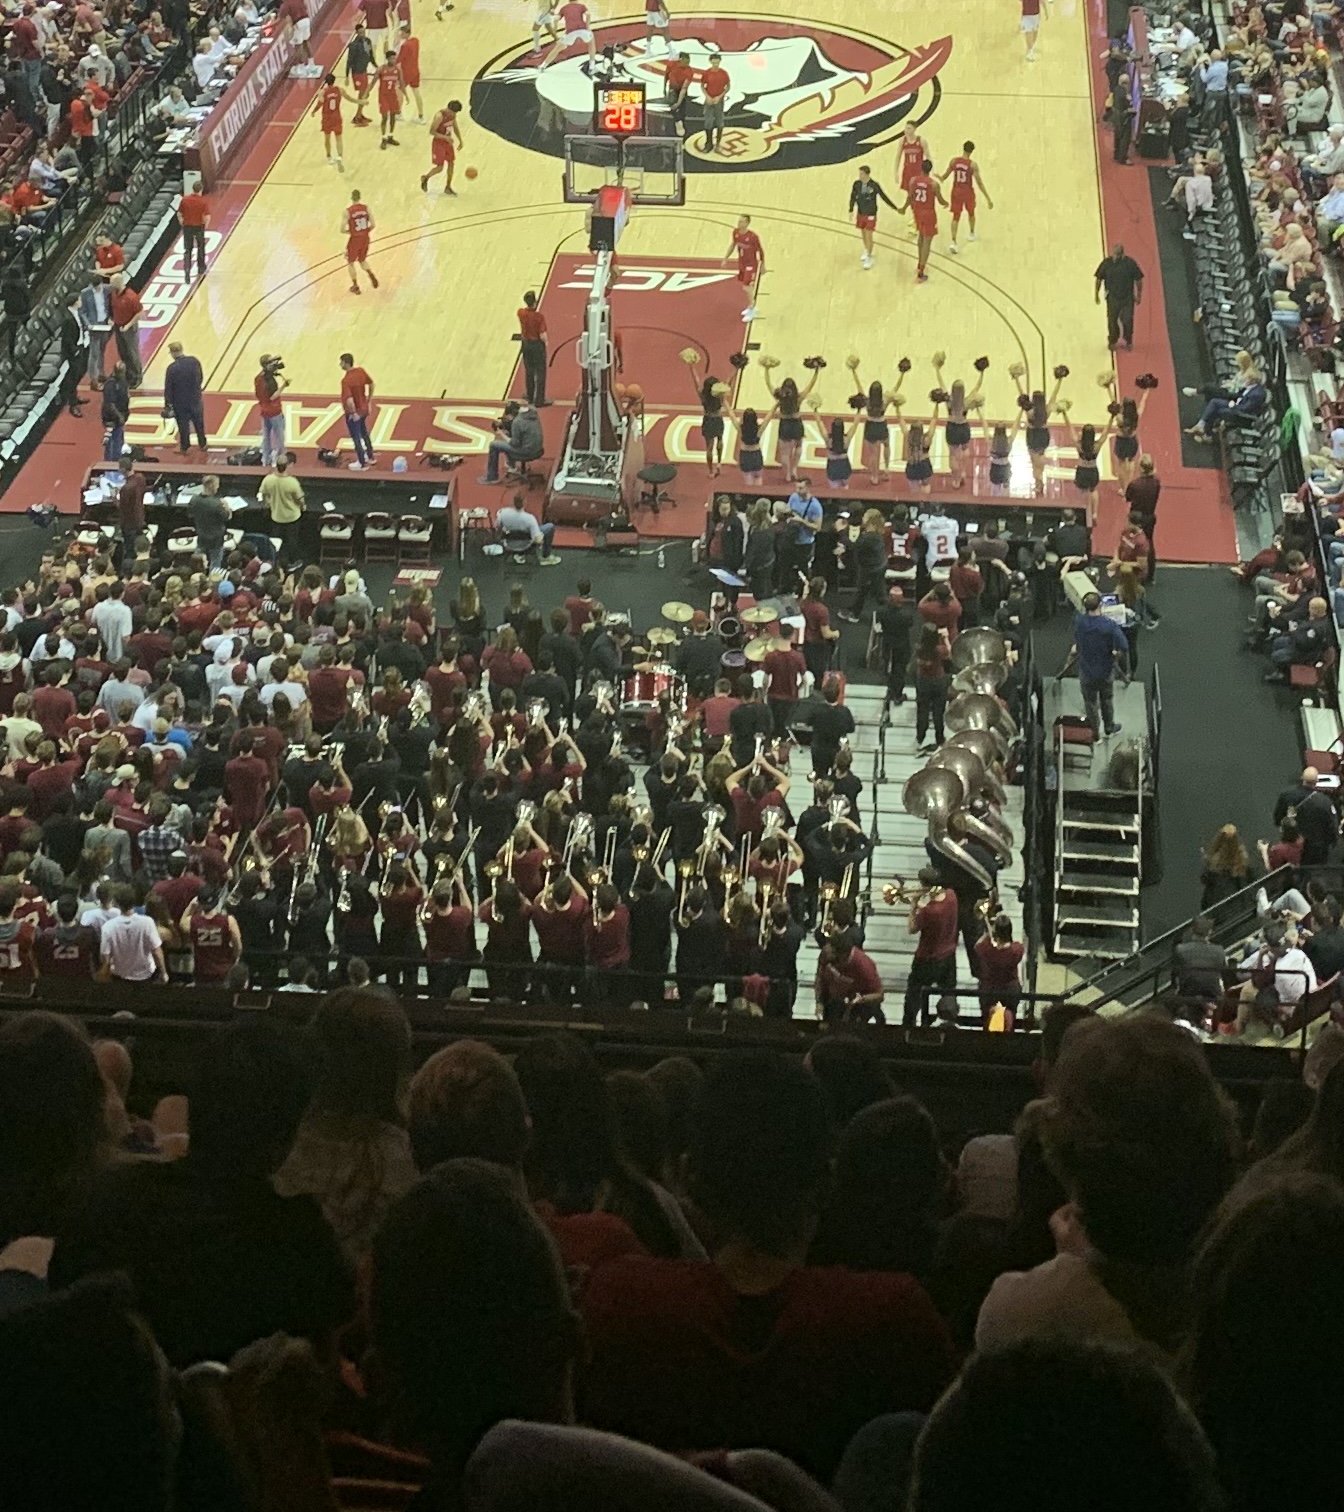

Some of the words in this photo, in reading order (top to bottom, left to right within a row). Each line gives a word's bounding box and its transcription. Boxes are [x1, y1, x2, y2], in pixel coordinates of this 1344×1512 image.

[210, 87, 258, 164] FLORIDA
[256, 38, 290, 96] STATE
[604, 104, 636, 130] 28
[138, 230, 223, 329] GEICO
[936, 534, 948, 555] 2
